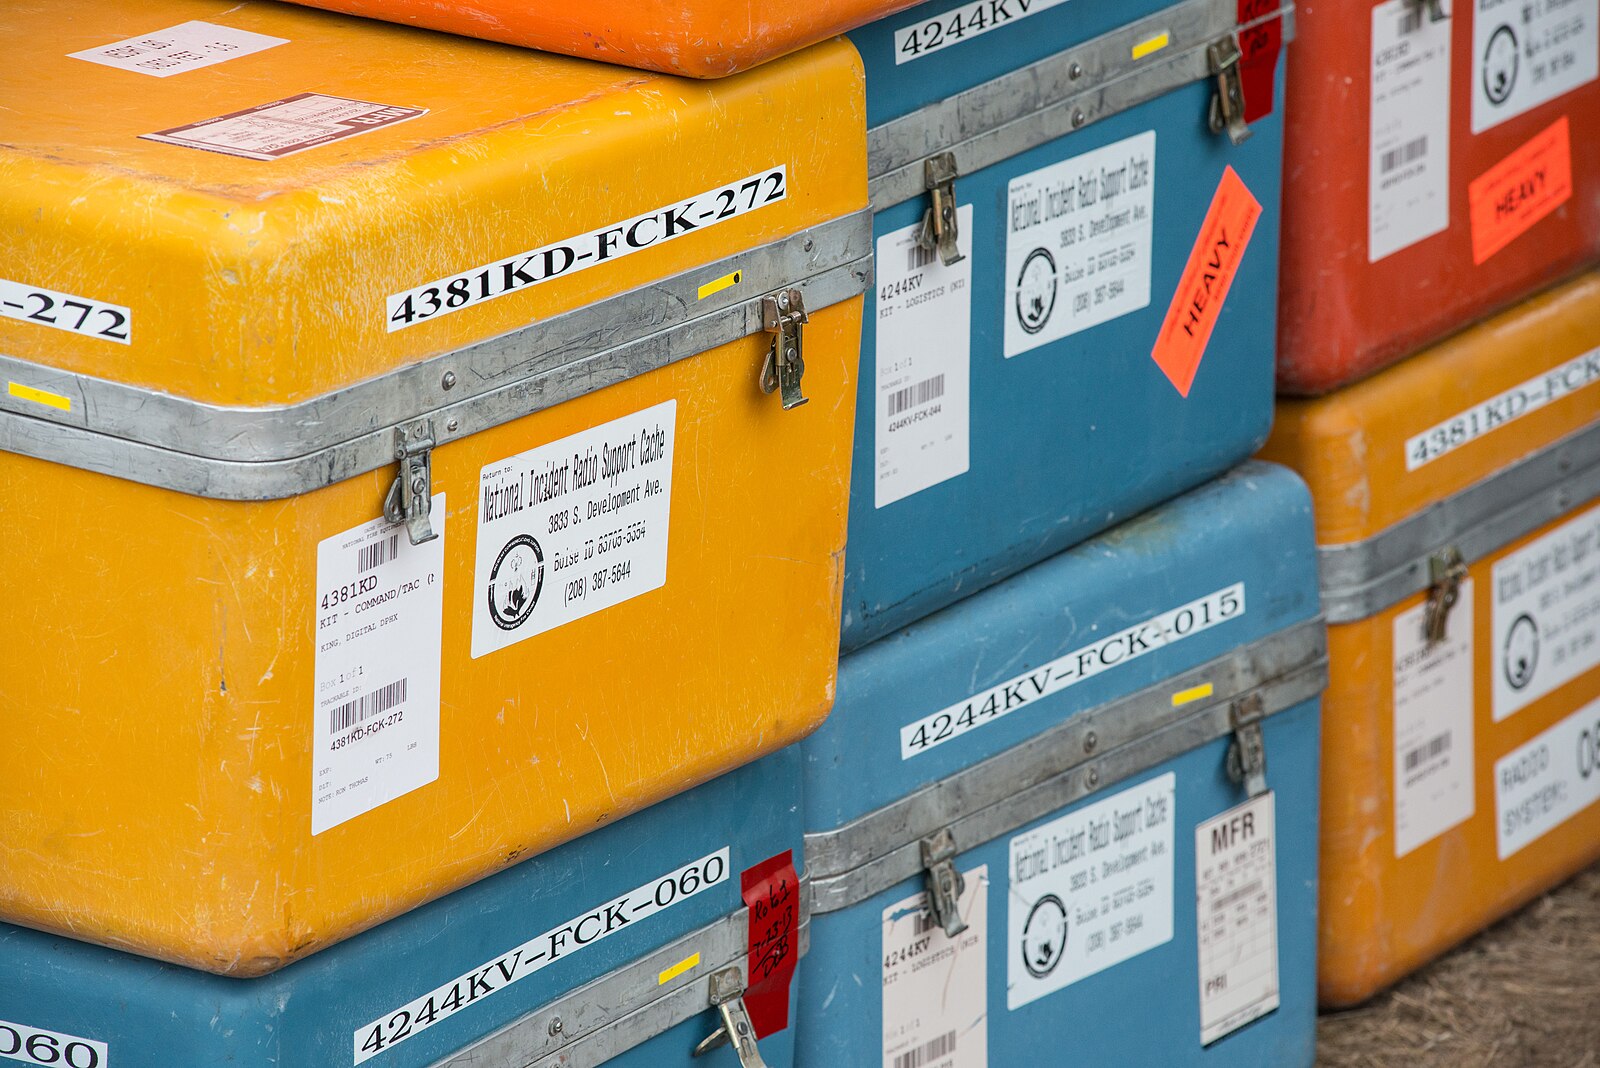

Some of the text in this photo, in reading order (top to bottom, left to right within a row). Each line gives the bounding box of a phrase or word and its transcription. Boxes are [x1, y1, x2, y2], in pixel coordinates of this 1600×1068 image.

[391, 171, 786, 324] 4381KD-FCK-272
[880, 273, 924, 301] 4244KV
[905, 286, 945, 309] LOGISTICS
[1184, 227, 1229, 337] HEAVY
[0, 292, 128, 340] -272
[482, 424, 665, 524] National Incident Radio Support Cache
[483, 470, 502, 480] Return
[548, 478, 663, 535] 3833 S. Development Ave.
[319, 613, 339, 630] KIT
[354, 579, 420, 614] COMMAND/TAC
[321, 575, 379, 610] 4381KD
[564, 560, 631, 608] (208) 387-5644
[346, 622, 377, 643] DIGITAL
[339, 673, 345, 684] 1
[358, 665, 364, 676] 1
[908, 589, 1239, 751] 4244KV-FCK-015
[329, 711, 404, 752] 4381KD-FCK-272
[1210, 811, 1255, 855] MFR
[360, 855, 725, 1054] 4244KV-FCK-060
[883, 936, 931, 969] 4244KV
